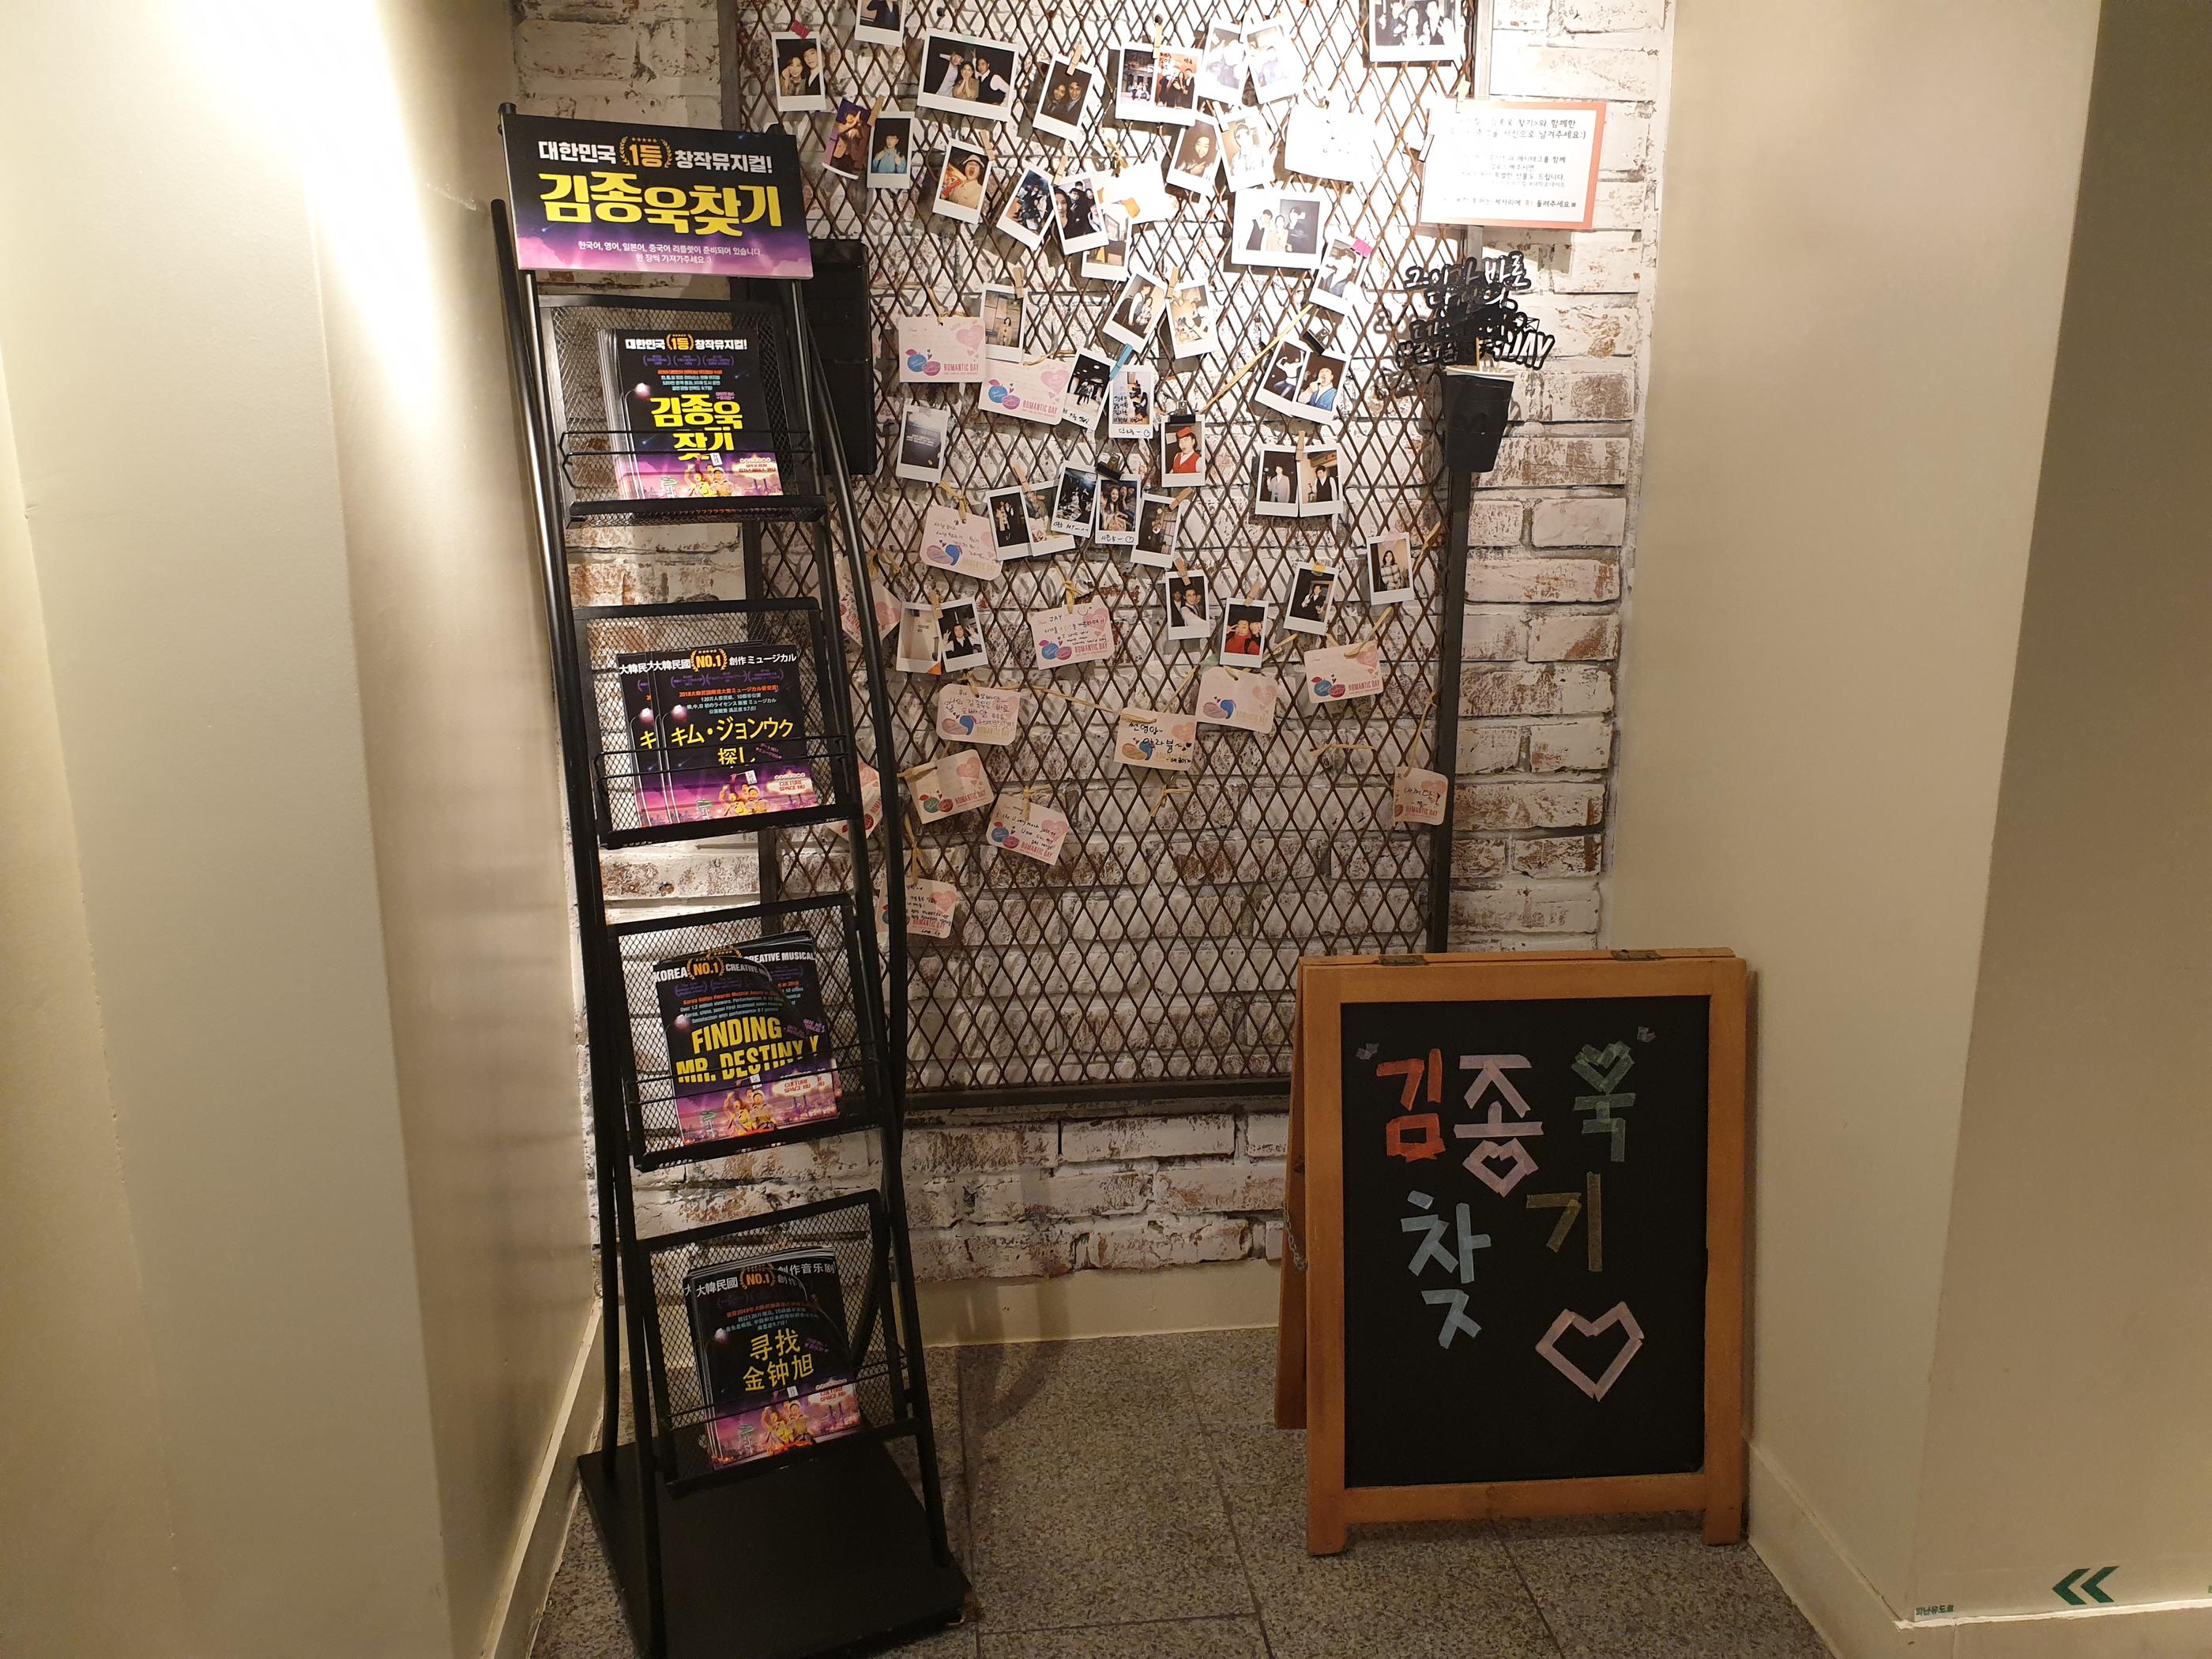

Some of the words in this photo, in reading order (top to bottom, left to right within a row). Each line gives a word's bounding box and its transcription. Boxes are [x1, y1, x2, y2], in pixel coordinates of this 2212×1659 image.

[538, 141, 616, 164] 대한민국
[629, 144, 663, 167] 1등
[675, 149, 773, 174] 창작뮤지컬!
[538, 171, 782, 236] 김종욱찾기
[578, 240, 604, 250] 한국어,
[604, 242, 623, 252] 영어,
[623, 243, 647, 252] 일본어,
[649, 243, 671, 253] 중국어
[672, 245, 702, 254] 리플렛이
[702, 246, 732, 255] 준비되어
[625, 338, 665, 350] 대한민국
[671, 337, 690, 350] 1등
[695, 339, 747, 350] 창작뮤지컬!
[943, 363, 969, 371] ROMANTIC
[969, 363, 979, 371] DAY
[650, 393, 743, 429] 김종욱
[1022, 399, 1048, 412] ROMANTIC
[1048, 405, 1058, 415] DAY
[1074, 644, 1099, 653] ROMANTIC
[1099, 642, 1108, 651] DAY
[695, 655, 722, 669] NO.1
[1348, 681, 1371, 691] ROMANTIC
[1371, 679, 1380, 688] DAY
[672, 716, 794, 747] キム・ジョンウク
[954, 792, 978, 804] ROMANTIC
[977, 789, 987, 798] DAY
[1021, 841, 1044, 855] ROMANTIC
[1044, 849, 1053, 858] DAY
[781, 951, 815, 961] MUSICAL
[652, 966, 688, 983] KOREA
[693, 962, 720, 976] NO.1
[692, 1016, 782, 1054] FINDING
[675, 1057, 717, 1083] MR.
[720, 1039, 804, 1080] DESTINY
[696, 1276, 739, 1297] 大韓民國
[746, 1273, 770, 1286] NO.1
[750, 1327, 801, 1361] 寻找
[743, 1353, 814, 1392] 金钟旭
